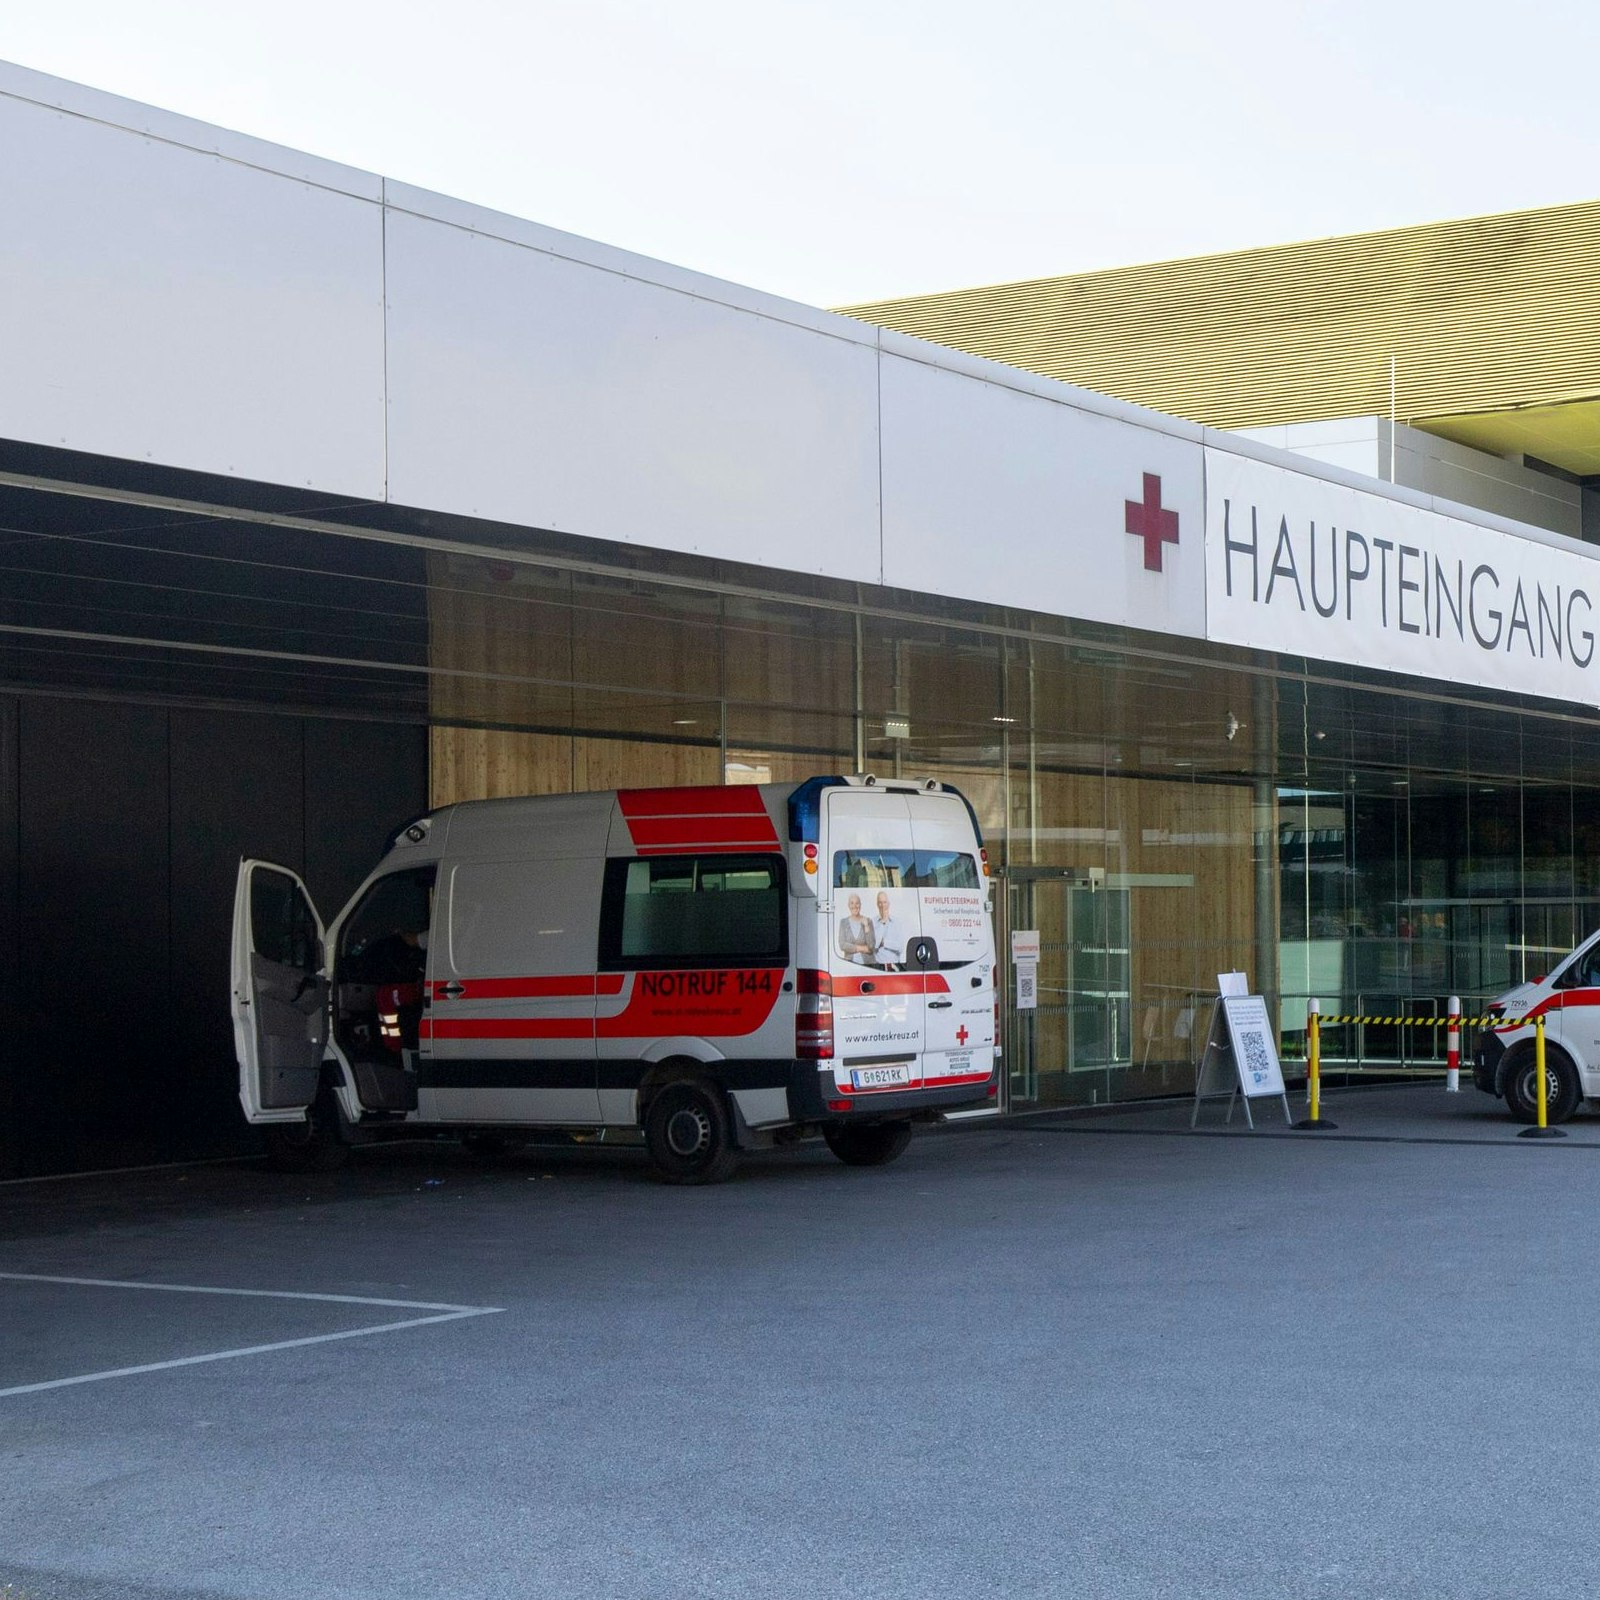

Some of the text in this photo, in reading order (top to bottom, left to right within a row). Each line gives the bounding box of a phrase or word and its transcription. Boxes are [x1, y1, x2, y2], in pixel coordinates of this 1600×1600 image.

[1223, 499, 1596, 669] HAUPTEINGANG
[641, 971, 772, 997] NOTRUF 144
[844, 1030, 919, 1043] www.roteskreuz.at
[863, 1071, 871, 1084] G
